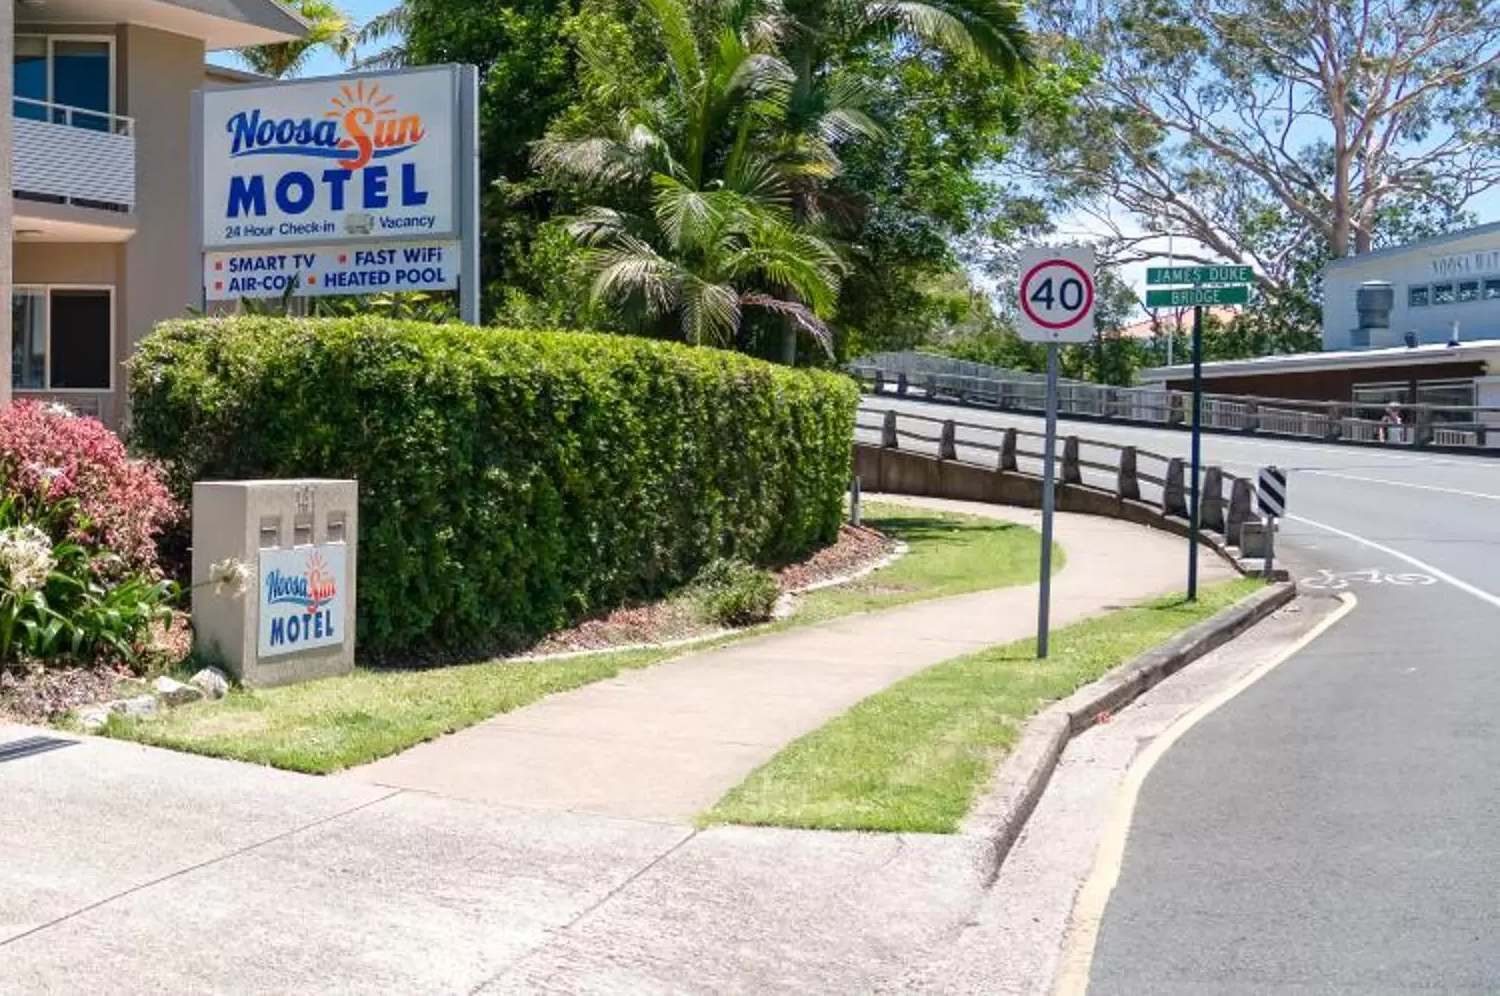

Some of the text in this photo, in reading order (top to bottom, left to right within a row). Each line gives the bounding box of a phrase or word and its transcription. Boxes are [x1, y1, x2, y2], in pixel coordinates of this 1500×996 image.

[226, 107, 425, 170] Noosa Sun
[226, 163, 429, 218] MOTEL
[226, 215, 436, 238] 24 Hour Check-in Vacancy
[229, 253, 316, 273] SMART TV
[355, 247, 444, 266] FAST WiFi
[324, 267, 446, 287] HEATED POOL
[1155, 267, 1247, 283] JAMES DUKE
[1030, 277, 1084, 311] 40
[1171, 289, 1221, 305] BRIDGE
[266, 570, 338, 614] Noosa Sun
[270, 610, 334, 646] MOTEL
